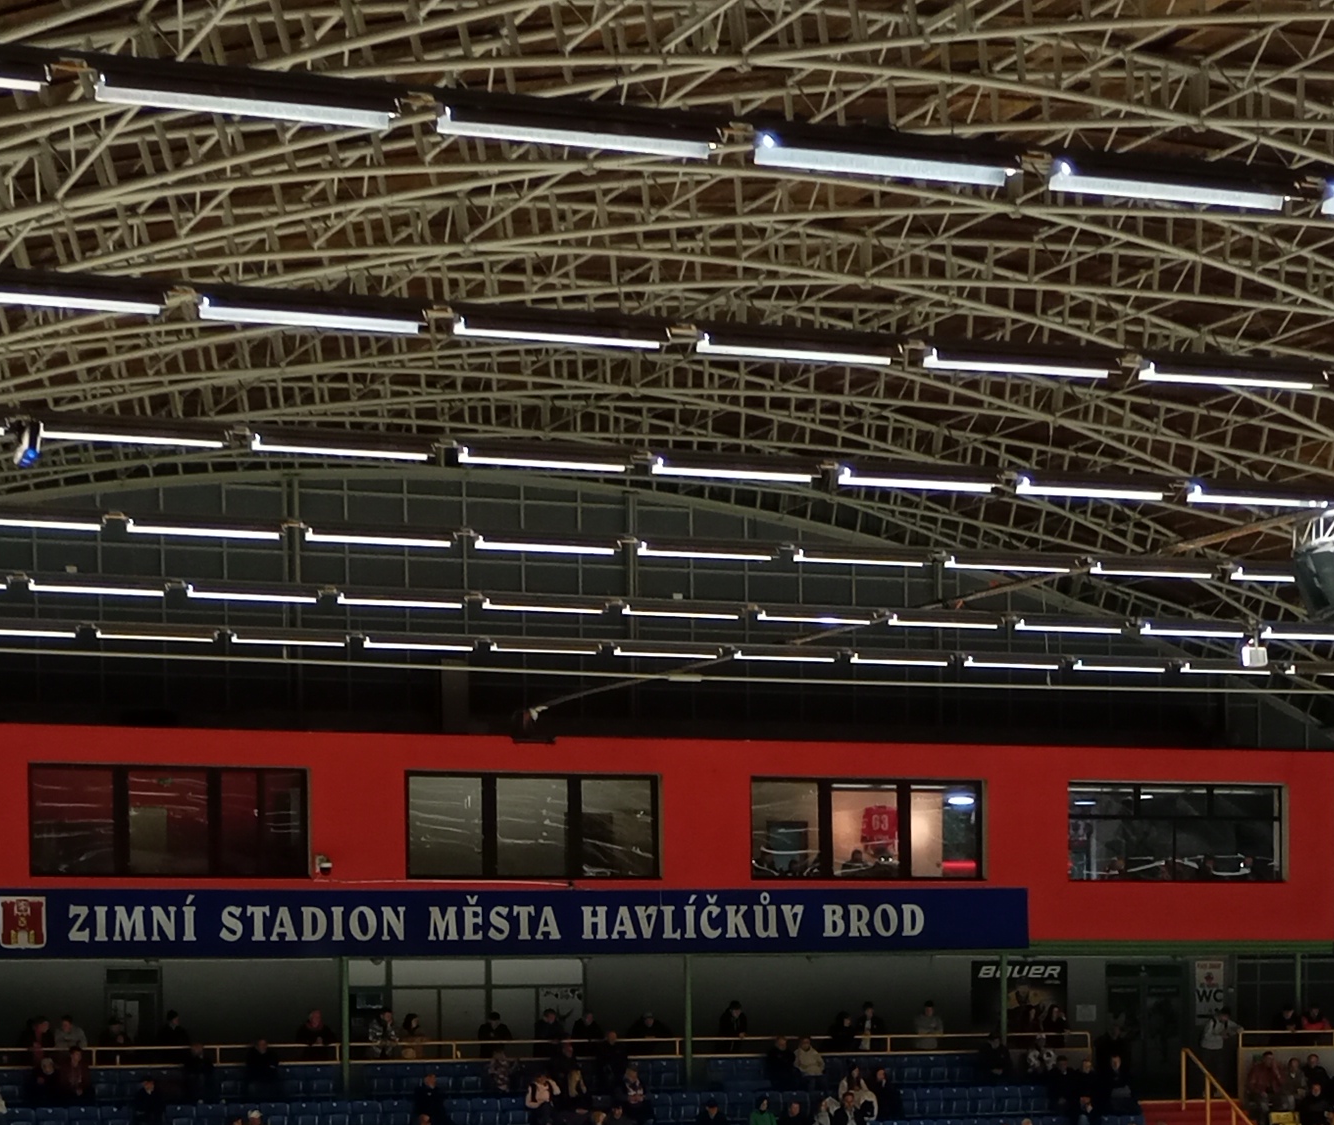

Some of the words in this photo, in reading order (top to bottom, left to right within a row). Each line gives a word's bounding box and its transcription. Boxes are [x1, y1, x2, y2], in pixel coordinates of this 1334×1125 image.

[68, 895, 196, 942] ZIMNÍ
[220, 904, 405, 942] STADION
[428, 896, 561, 942] MĚSTA
[582, 891, 804, 940] HAVLÍČKŮV
[823, 903, 925, 938] BROD
[1196, 989, 1224, 1003] WC
